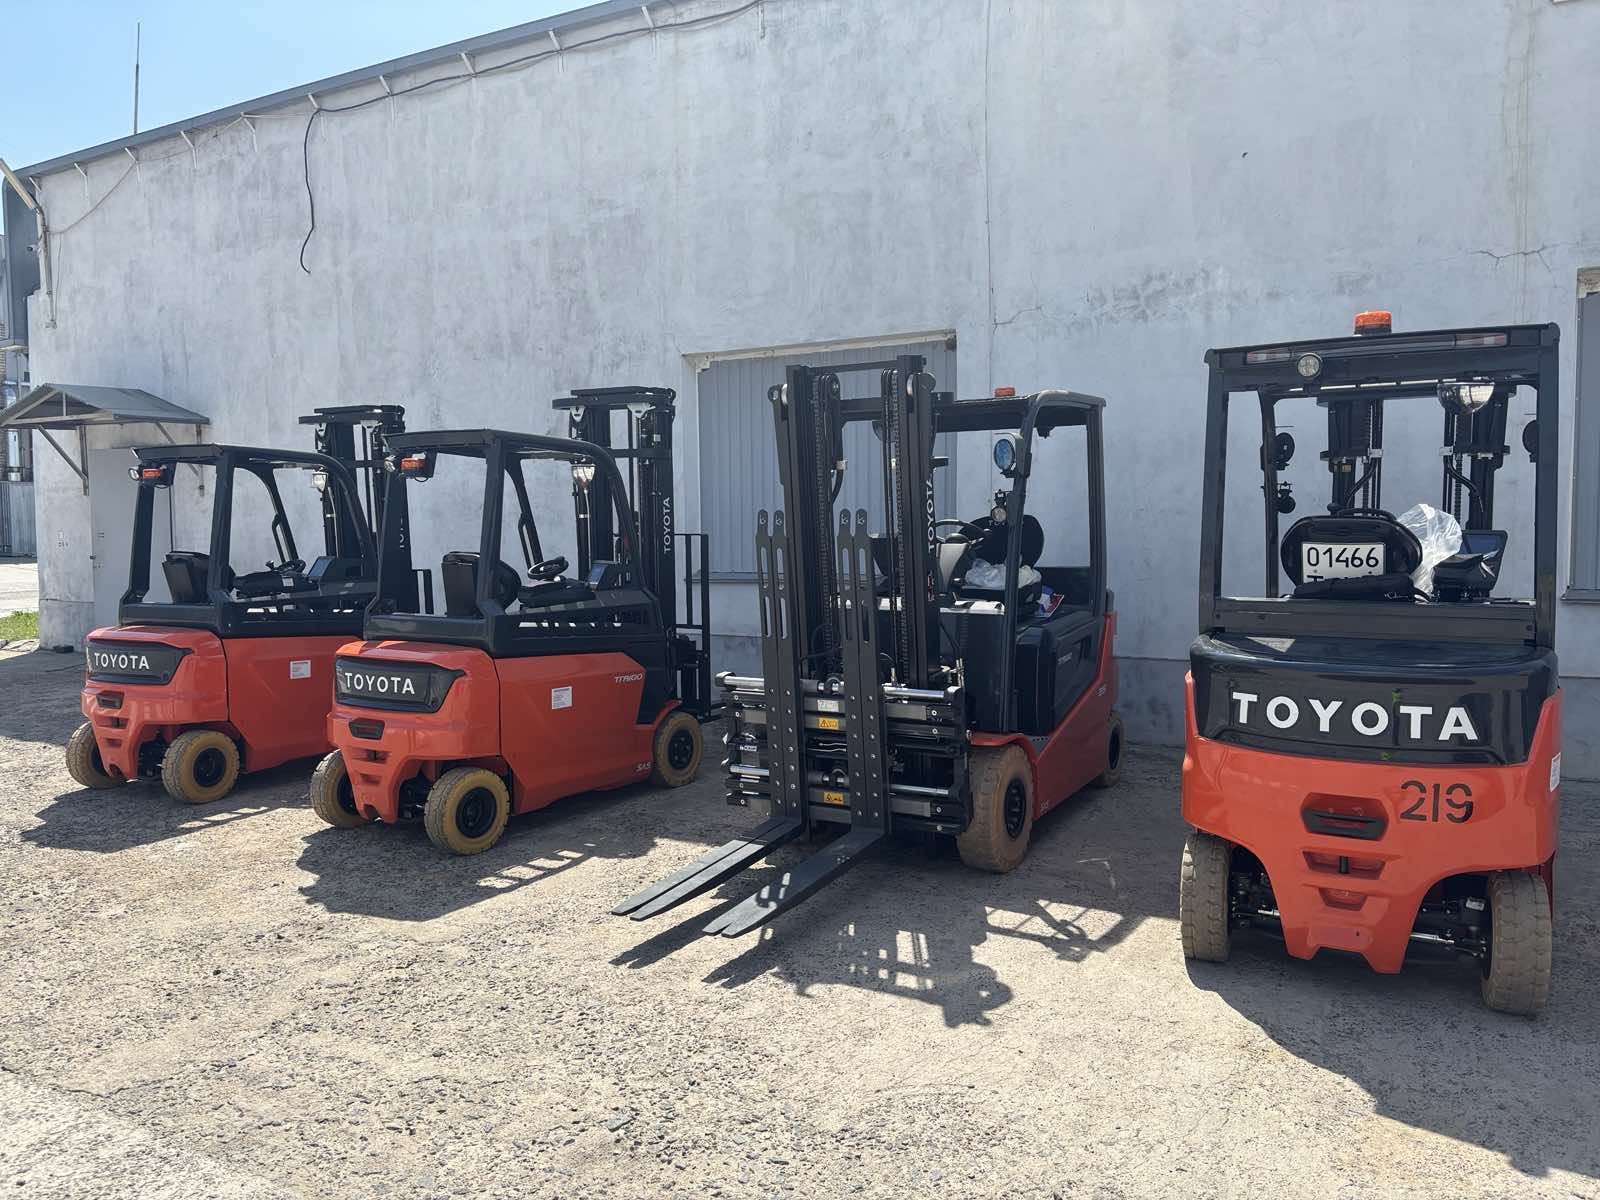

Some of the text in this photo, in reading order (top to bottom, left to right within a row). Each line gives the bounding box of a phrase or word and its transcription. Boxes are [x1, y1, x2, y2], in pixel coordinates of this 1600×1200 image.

[663, 497, 671, 554] TOYOTA
[1307, 547, 1379, 568] 01466
[94, 652, 150, 670] TOYOTA
[344, 672, 415, 694] TOYOTA
[1232, 691, 1478, 741] TOYOTA
[1400, 780, 1473, 823] 219
